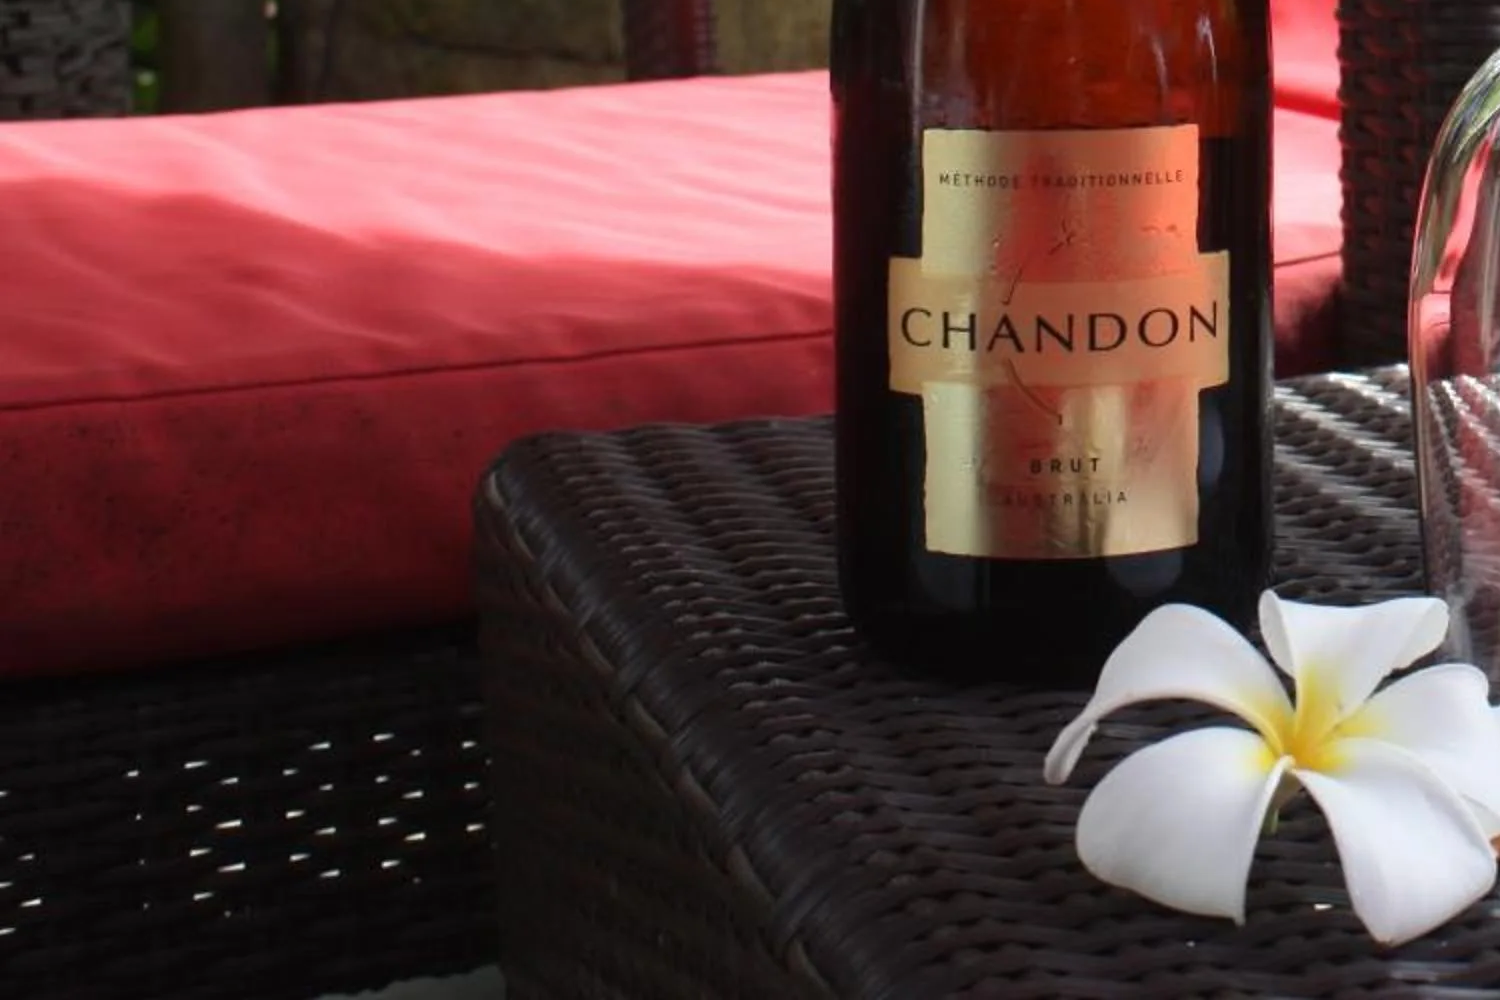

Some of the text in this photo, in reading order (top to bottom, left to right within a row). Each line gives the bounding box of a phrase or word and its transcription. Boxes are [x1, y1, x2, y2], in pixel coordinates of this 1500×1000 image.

[1029, 168, 1186, 188] TRADITIONNELLE
[900, 300, 1218, 353] CHANDON
[1029, 457, 1100, 475] BRUT
